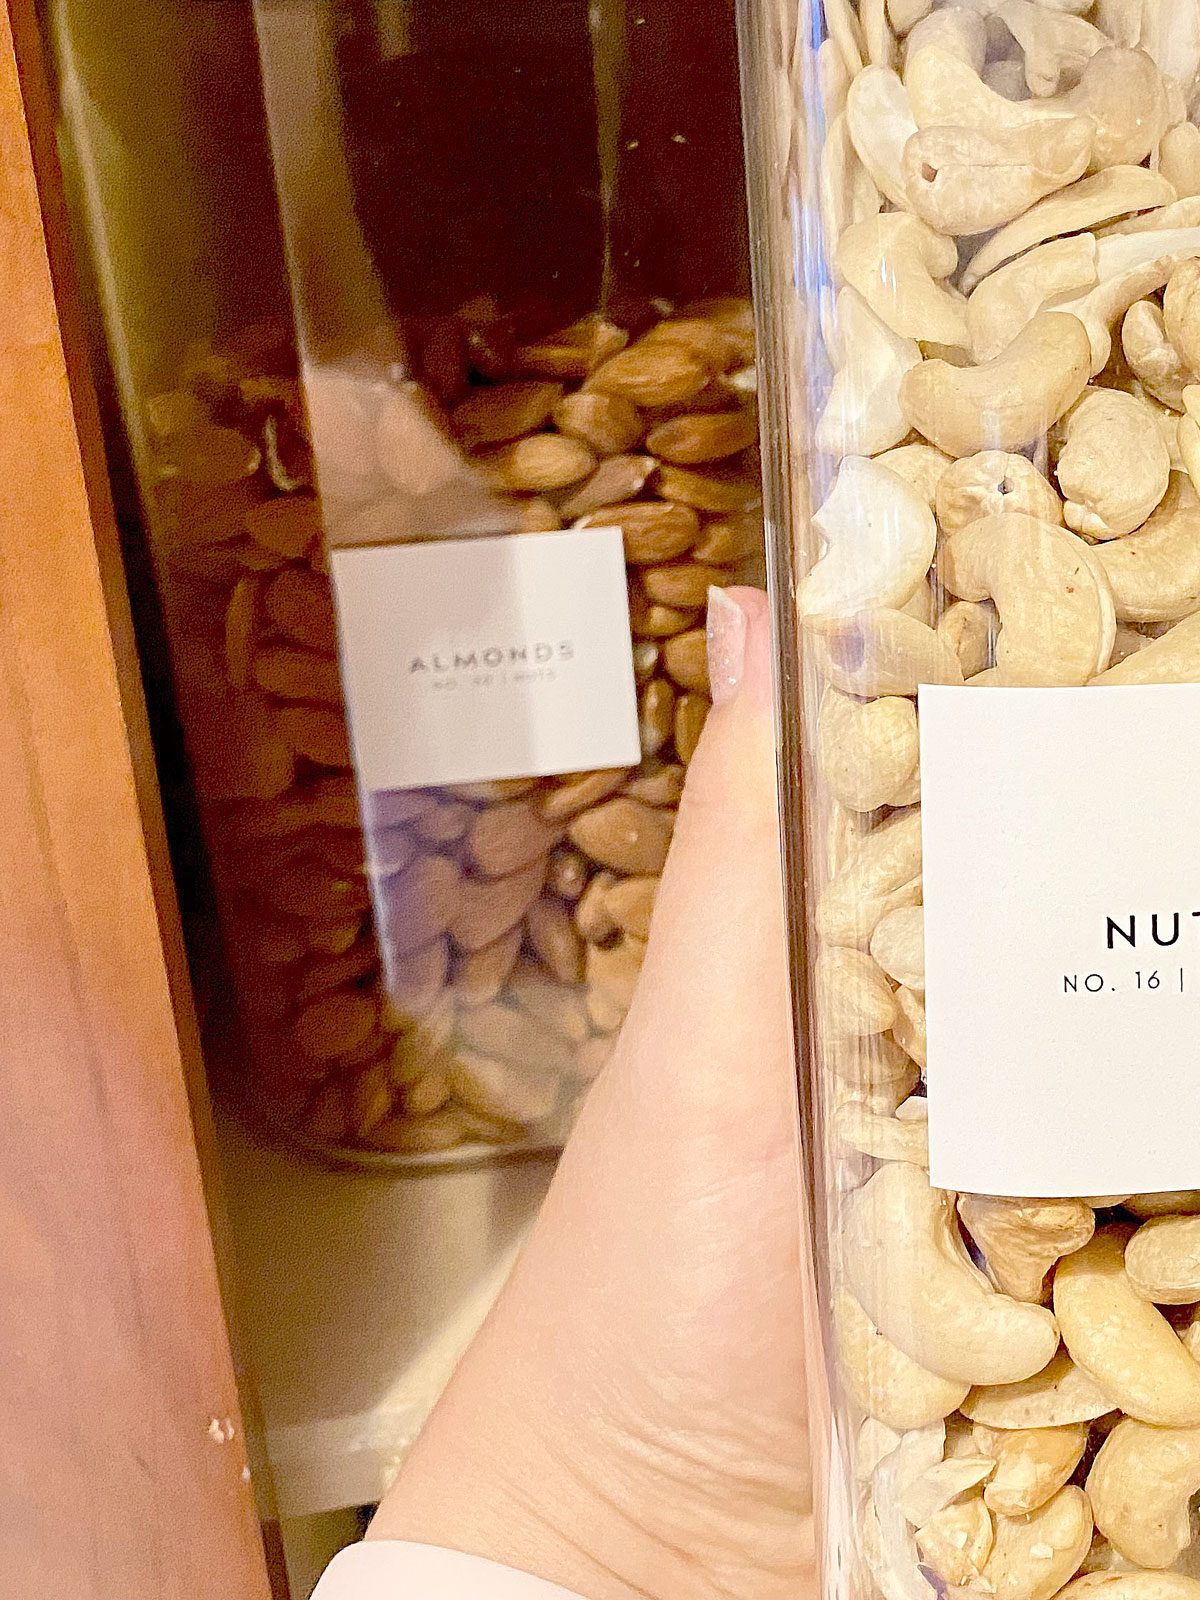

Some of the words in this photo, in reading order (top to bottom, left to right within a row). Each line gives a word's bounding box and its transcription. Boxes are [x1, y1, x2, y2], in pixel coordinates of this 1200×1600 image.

[409, 639, 574, 673] ALMONDS
[1063, 973, 1116, 993] NO.
[1135, 970, 1161, 990] 16
